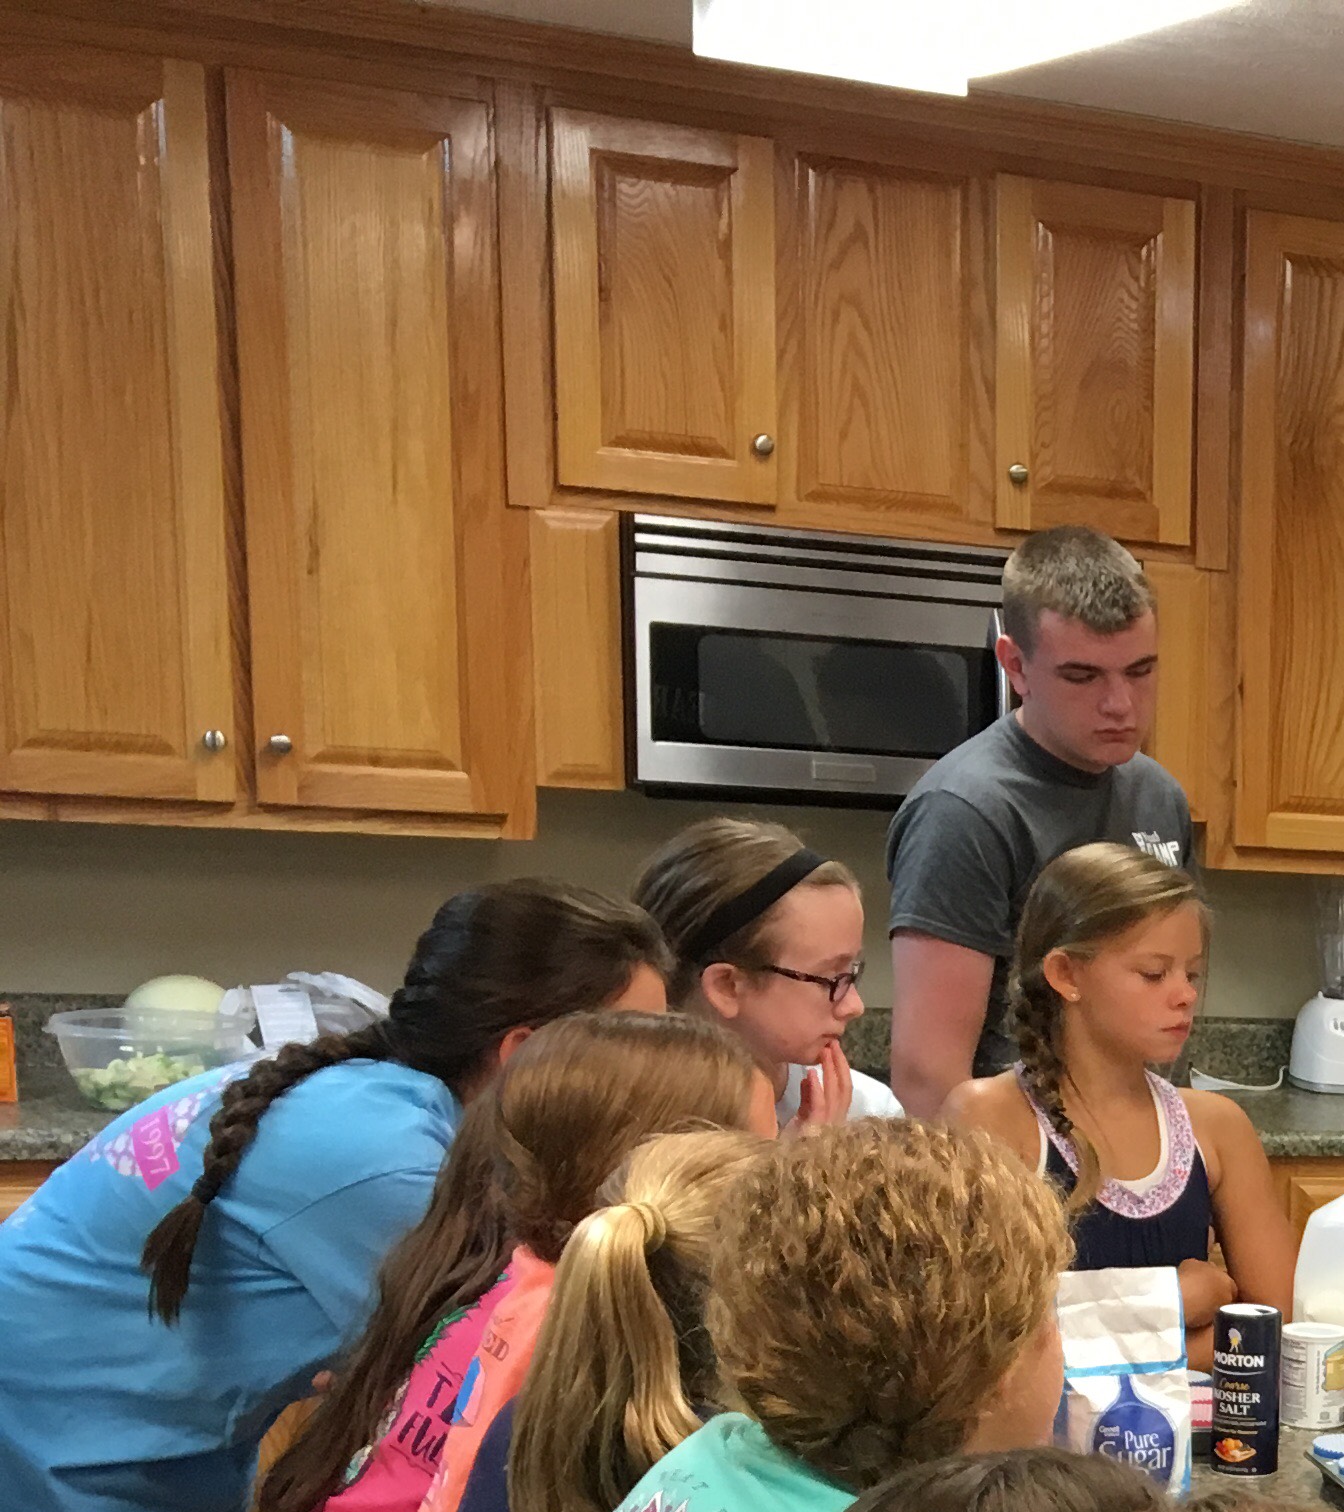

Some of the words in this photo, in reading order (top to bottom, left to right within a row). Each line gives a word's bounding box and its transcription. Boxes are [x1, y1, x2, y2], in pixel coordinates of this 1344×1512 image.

[140, 1117, 171, 1174] 1997
[1214, 1350, 1265, 1368] MORTON
[1214, 1388, 1261, 1404] KOSHER
[1219, 1401, 1251, 1416] SALT
[1124, 1430, 1160, 1450] Pure
[1098, 1440, 1172, 1475] Sugar
